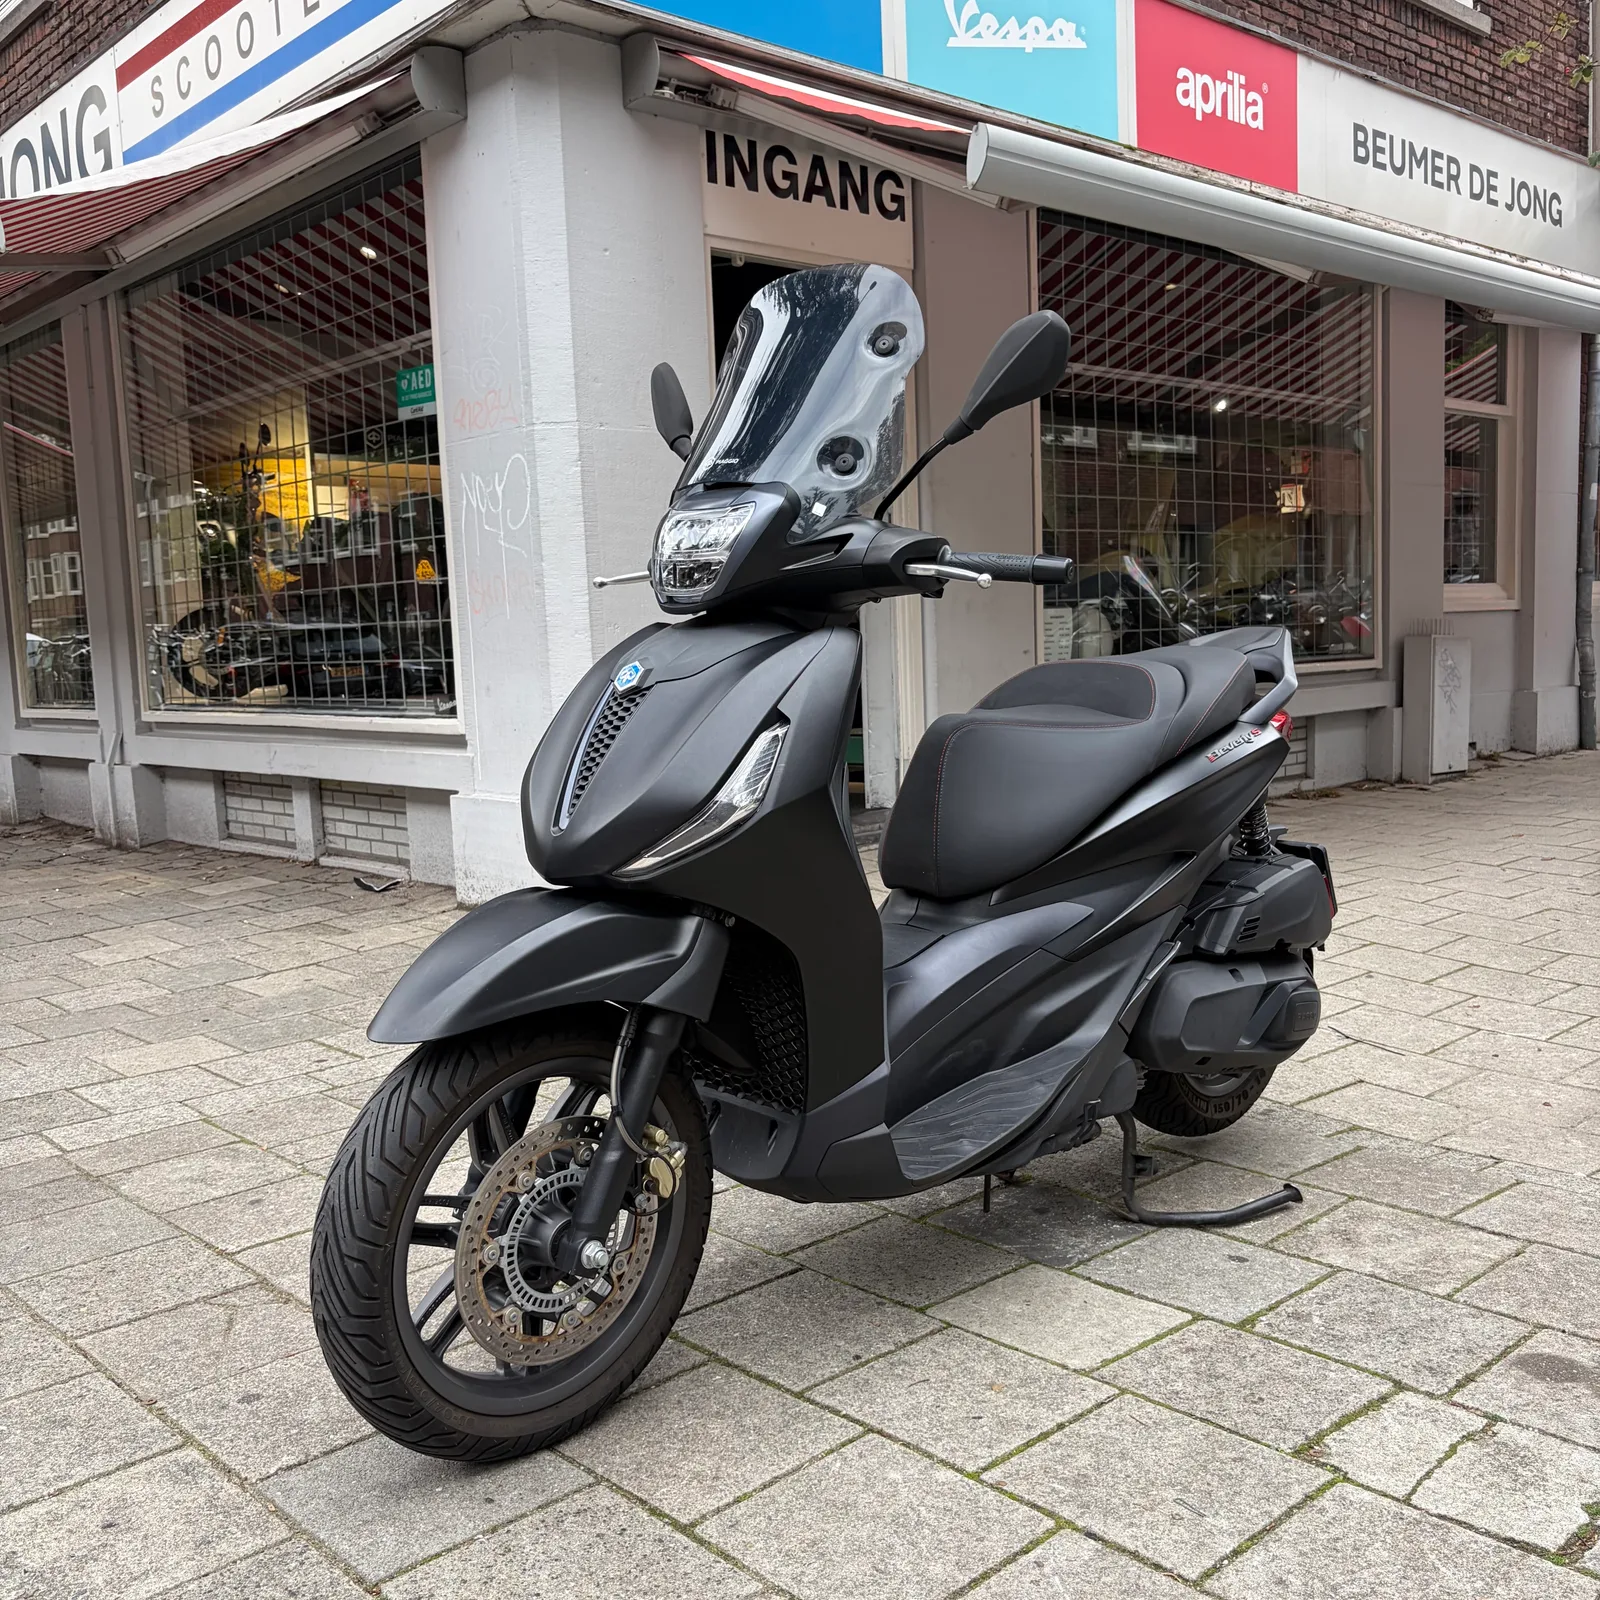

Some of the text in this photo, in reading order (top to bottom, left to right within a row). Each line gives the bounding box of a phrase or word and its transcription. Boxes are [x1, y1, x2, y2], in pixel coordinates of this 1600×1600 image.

[944, 0, 1087, 52] Vespa
[1176, 67, 1264, 131] aprilia
[705, 129, 906, 222] INGANG
[1353, 122, 1563, 228] BEUMER DE JONG
[411, 368, 431, 391] AED
